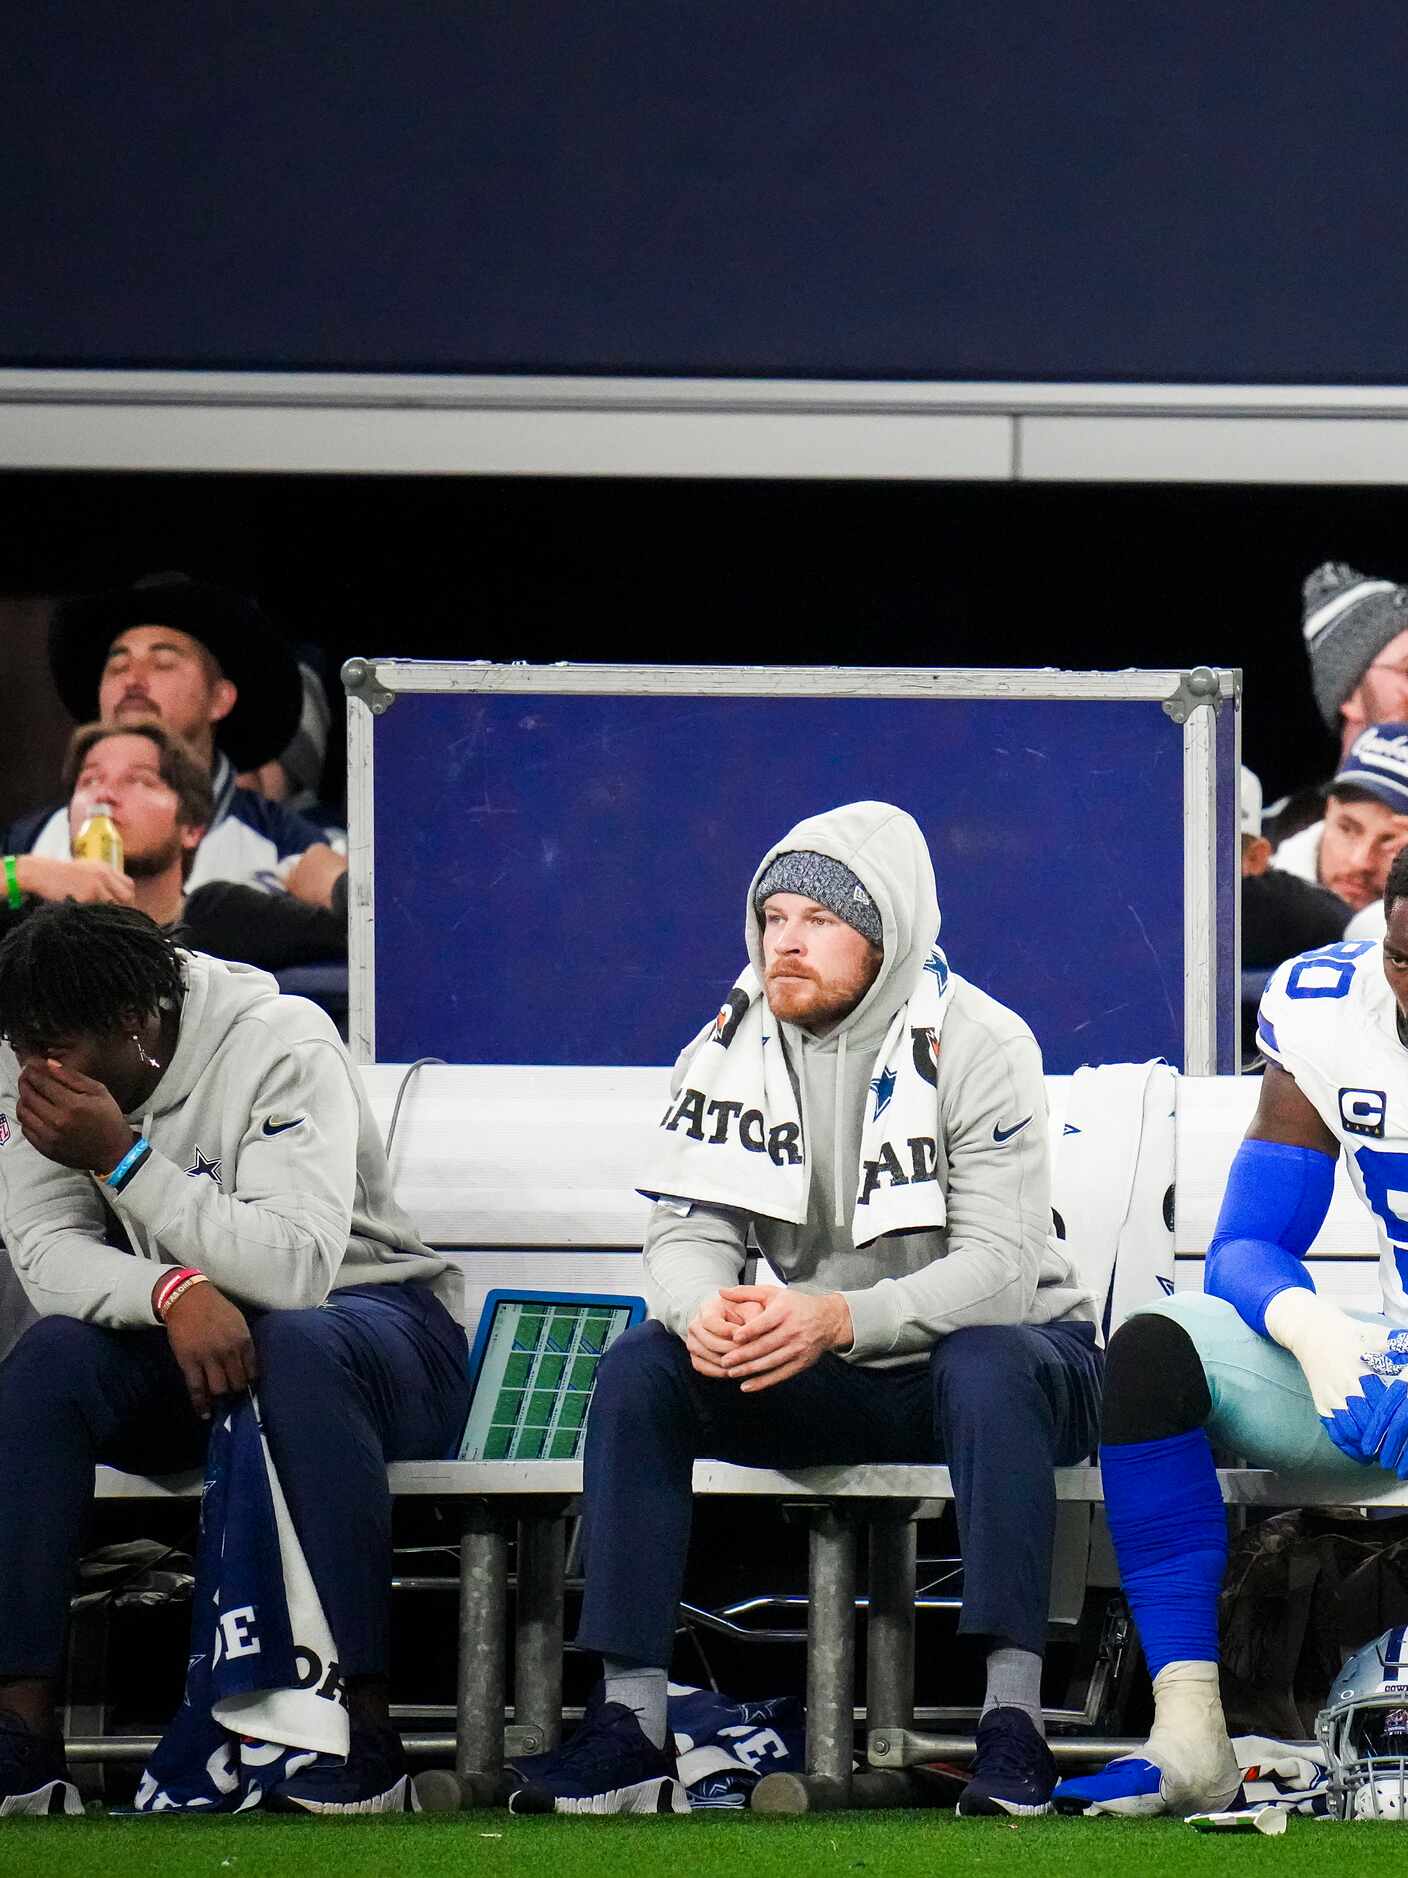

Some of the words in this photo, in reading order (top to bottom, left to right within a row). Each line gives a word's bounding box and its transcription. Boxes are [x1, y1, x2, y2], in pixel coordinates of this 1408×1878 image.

[660, 1088, 805, 1167] ATOR
[1341, 1091, 1383, 1127] C
[213, 1606, 261, 1668] E
[718, 1726, 790, 1775] E
